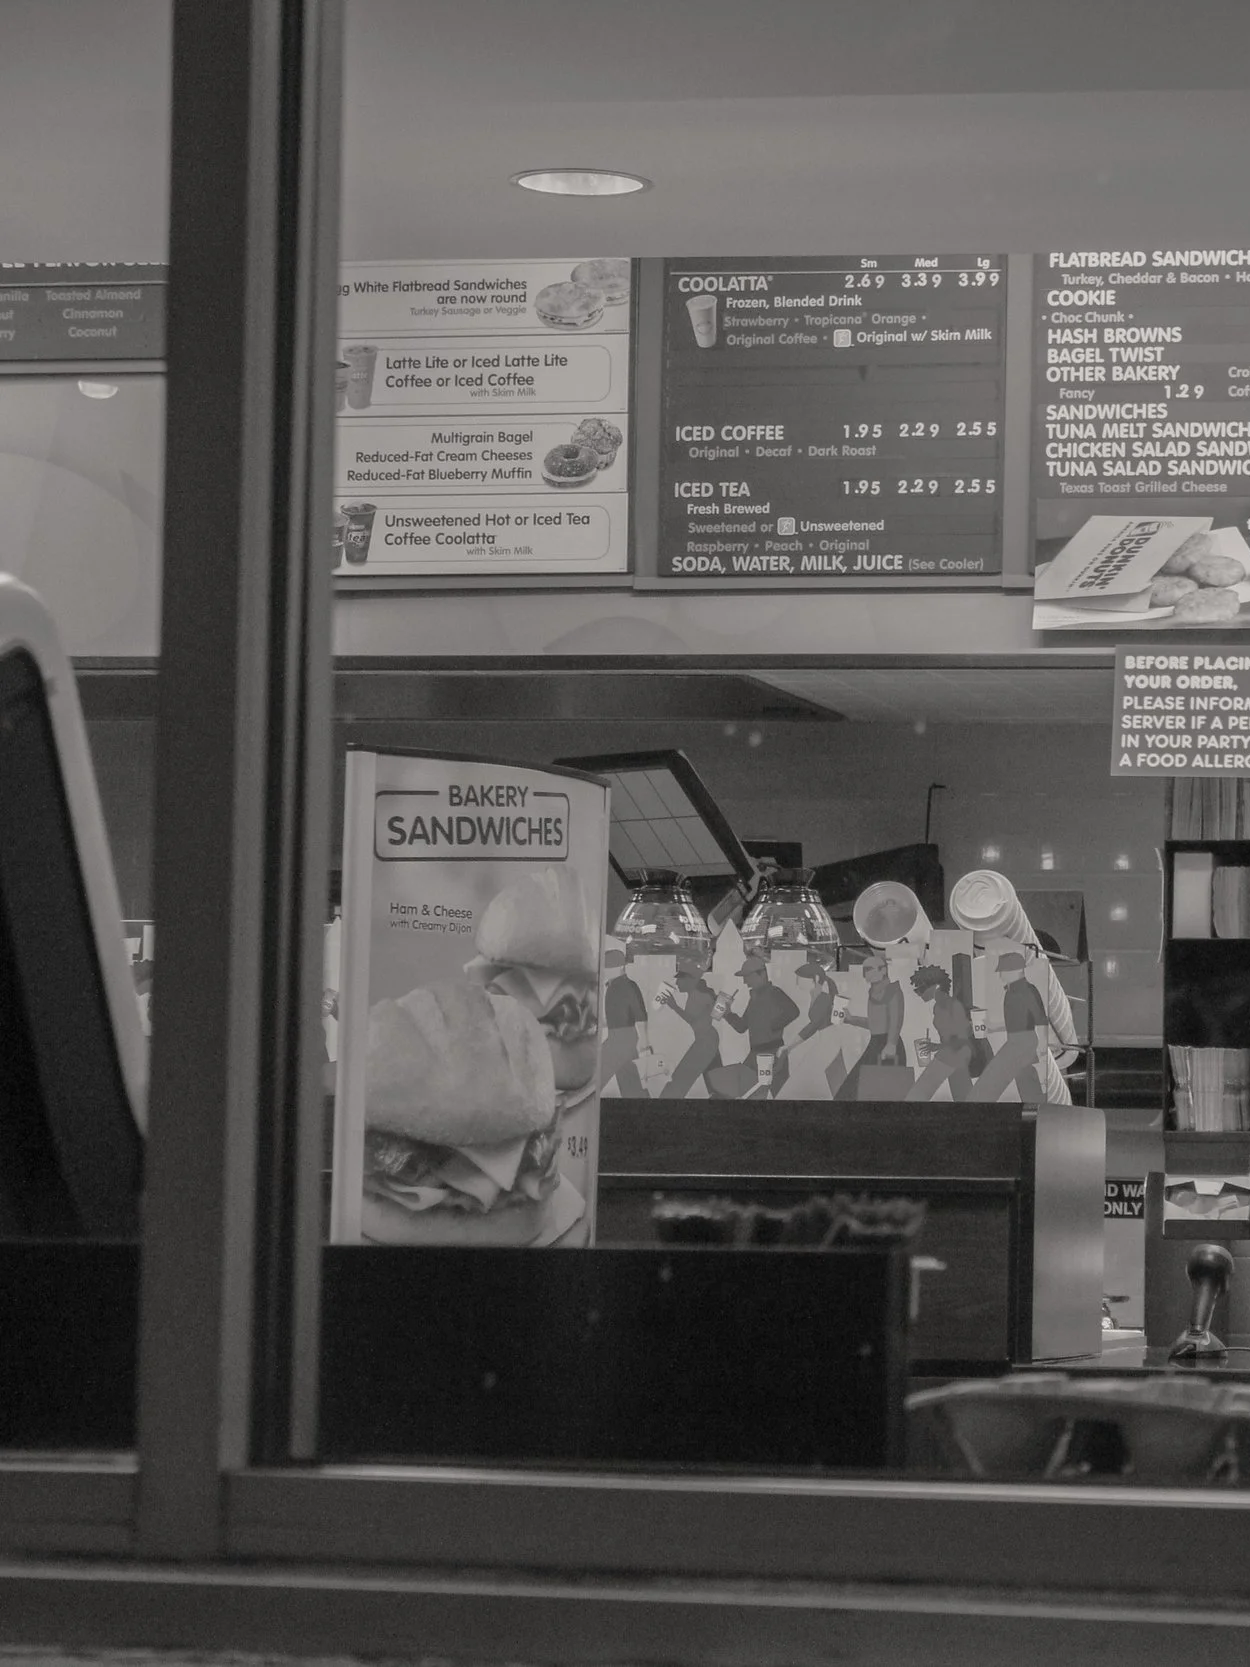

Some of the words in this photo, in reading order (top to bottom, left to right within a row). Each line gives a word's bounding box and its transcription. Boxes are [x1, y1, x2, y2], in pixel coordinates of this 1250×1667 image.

[861, 259, 877, 267] Sm
[914, 258, 938, 267] Med
[977, 258, 990, 269] Lg
[1050, 251, 1146, 267] FLATBREAD
[354, 282, 389, 293] White
[393, 281, 449, 292] Flatbread
[454, 280, 526, 292] Sandwiches
[845, 274, 884, 288] 2.69
[901, 272, 941, 287] 3.39
[959, 272, 999, 286] 3.99
[46, 290, 91, 300] Toasted
[95, 289, 141, 300] Almond
[1047, 290, 1115, 306] COOKIE
[62, 308, 123, 319] Cinnamon
[68, 326, 116, 337] Coconut
[1048, 328, 1097, 344] HASH
[1104, 326, 1182, 343] BROWNS
[1047, 348, 1104, 363] BAGEL
[1109, 346, 1164, 362] TWIST
[1046, 366, 1105, 382] OTHER
[1112, 365, 1180, 381] BAKERY
[1046, 403, 1167, 420] SANDWICHES
[676, 426, 714, 441] ICED
[721, 425, 784, 440] COFFEE
[844, 424, 881, 438] 1.95
[899, 422, 939, 437] 2.29
[957, 421, 996, 436] 2.55
[1045, 423, 1096, 439] TUNA
[1102, 423, 1147, 438] MELT
[431, 431, 493, 446] Multigrain
[498, 431, 532, 445] Bagel
[1046, 442, 1125, 458] CHICKEN
[1132, 441, 1190, 457] SALAD
[1046, 461, 1097, 476] TUNA
[1103, 460, 1161, 476] SALAD
[675, 482, 713, 497] ICED
[719, 482, 750, 497] TEA
[843, 480, 880, 494] 1.95
[898, 479, 938, 493] 2.29
[955, 479, 995, 493] 2.55
[385, 514, 480, 527] Unsweetened
[485, 514, 510, 525] Hot
[514, 516, 529, 525] or
[533, 513, 561, 525] Iced
[566, 513, 589, 524] Tea
[672, 556, 725, 573] SODA,
[732, 556, 794, 573] WATER,
[801, 555, 847, 573] MILK,
[853, 554, 903, 570] JUICE
[1079, 538, 1136, 588] DONUTS
[1125, 656, 1188, 669] BEFORE
[1124, 675, 1171, 688] YOUR
[1176, 675, 1237, 690] ORDER,
[1123, 696, 1184, 710] PLEASE
[1121, 715, 1185, 729] SERVER
[1191, 716, 1206, 729] IF
[1210, 716, 1222, 729] A
[1121, 734, 1139, 747] IN
[1145, 734, 1192, 748] YOUR
[1197, 735, 1250, 748] PARTY
[1119, 753, 1131, 766] A
[1137, 753, 1187, 767] FOOD
[449, 785, 528, 807] BAKERY
[388, 816, 562, 846] SANDWICHES
[390, 902, 417, 914] Ham
[422, 904, 430, 915] &
[434, 905, 472, 919] Cheese
[390, 919, 409, 928] with
[412, 919, 446, 933] Creamy
[449, 922, 471, 934] Dijon
